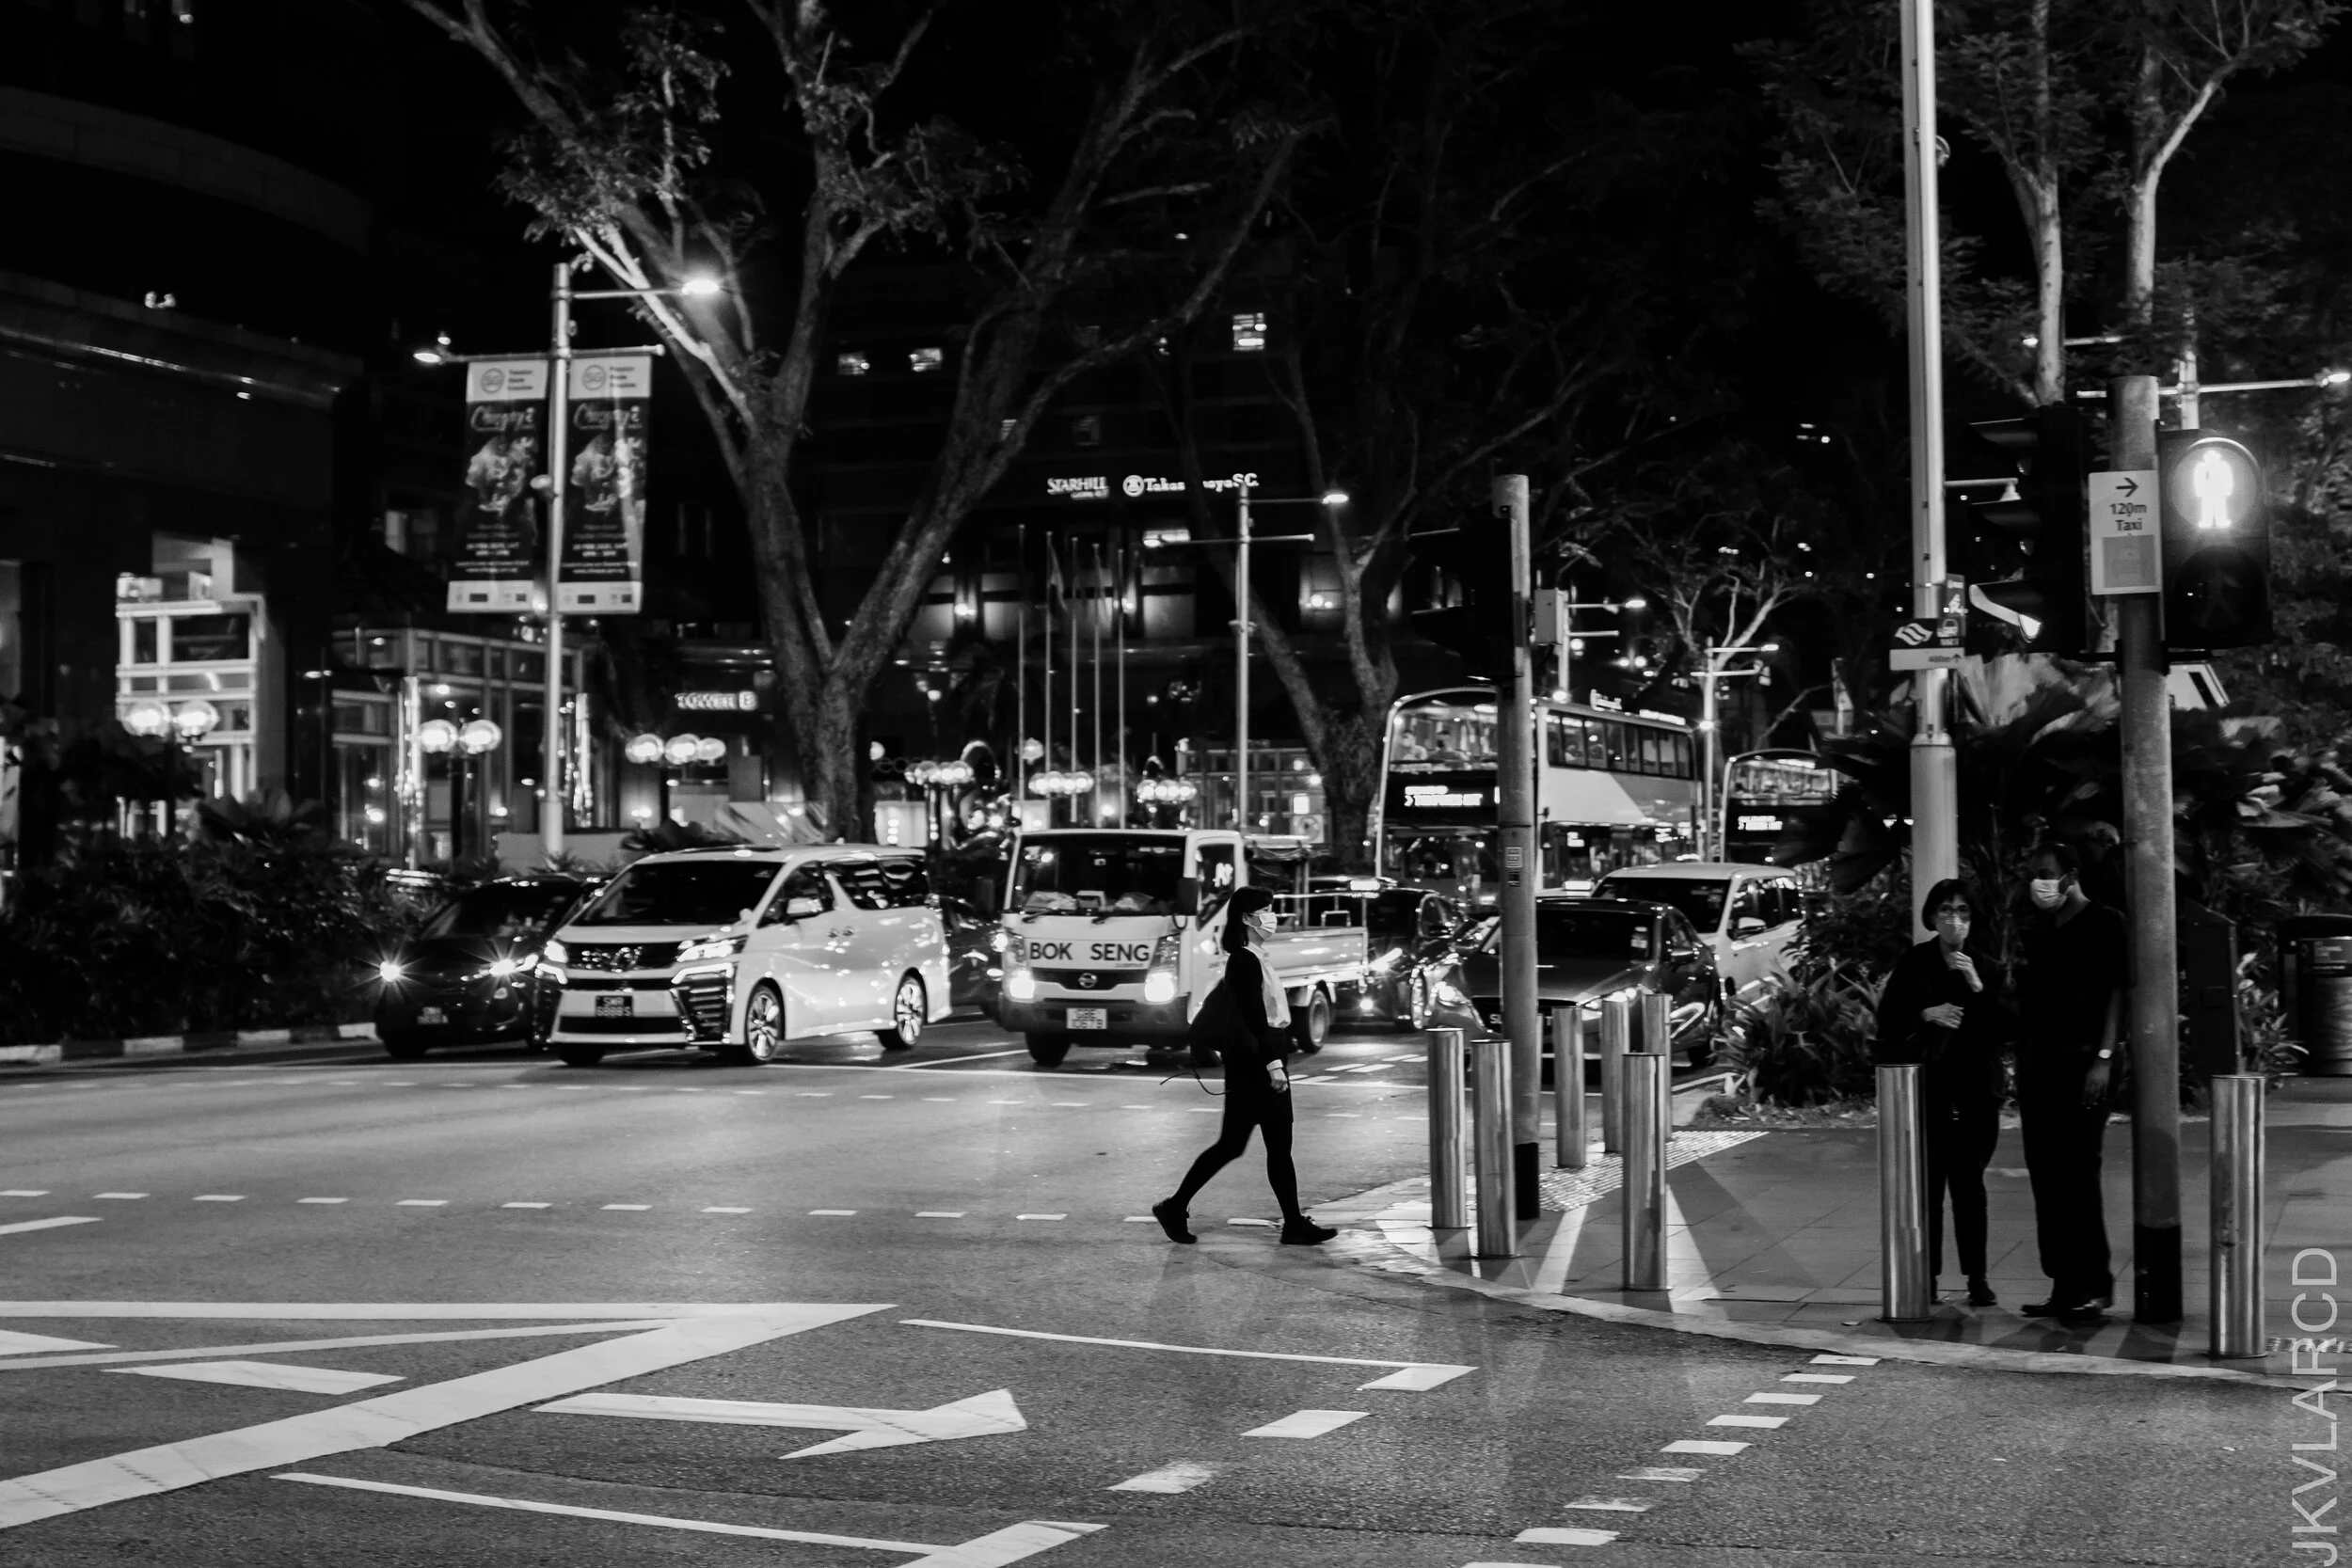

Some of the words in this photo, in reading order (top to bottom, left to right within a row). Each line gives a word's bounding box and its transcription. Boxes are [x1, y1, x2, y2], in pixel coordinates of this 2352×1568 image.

[1047, 476, 1108, 494] STARHILL
[2109, 502, 2147, 515] 120m
[2115, 518, 2143, 531] Taxi
[1029, 942, 1073, 961] BOK
[1089, 942, 1150, 962] SENG
